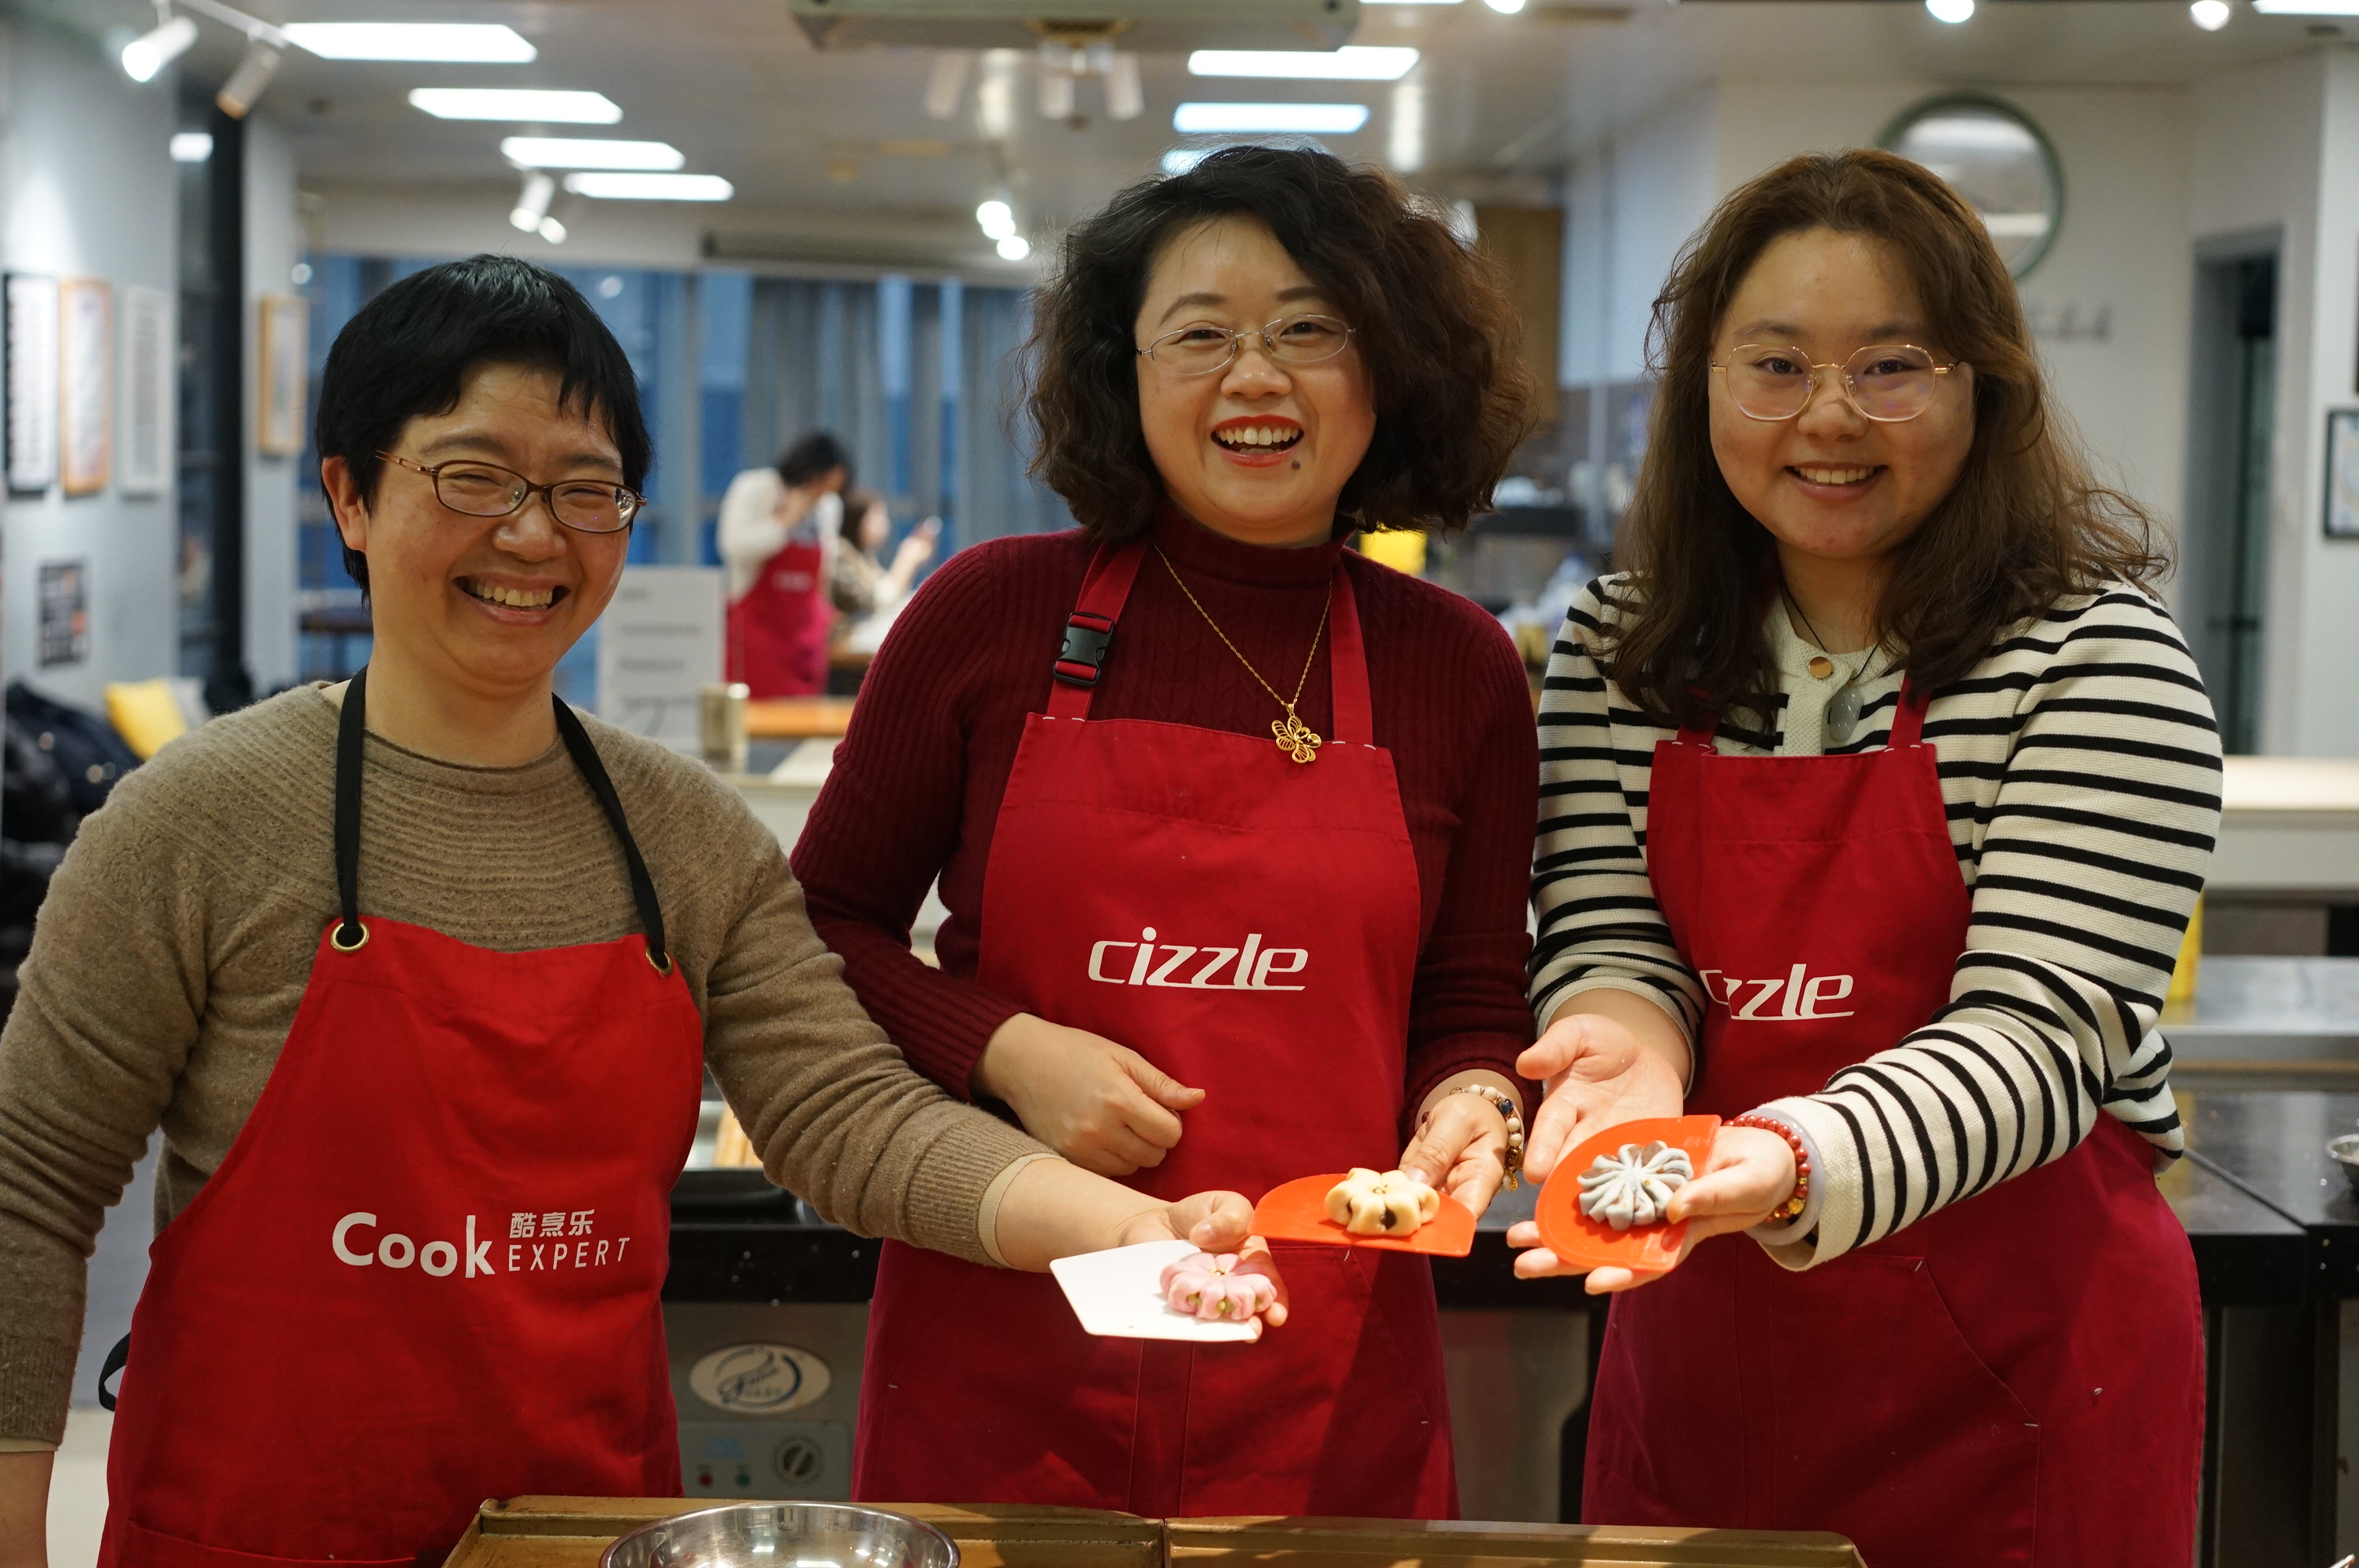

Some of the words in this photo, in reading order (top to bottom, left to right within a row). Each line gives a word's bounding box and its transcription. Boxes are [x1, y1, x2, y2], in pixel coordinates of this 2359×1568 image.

[1088, 927, 1309, 991] cizzle
[1699, 963, 1856, 1021] czle
[332, 1211, 496, 1279] Cook
[509, 1209, 595, 1239] 酷烹乐
[508, 1237, 631, 1272] EXPERT
